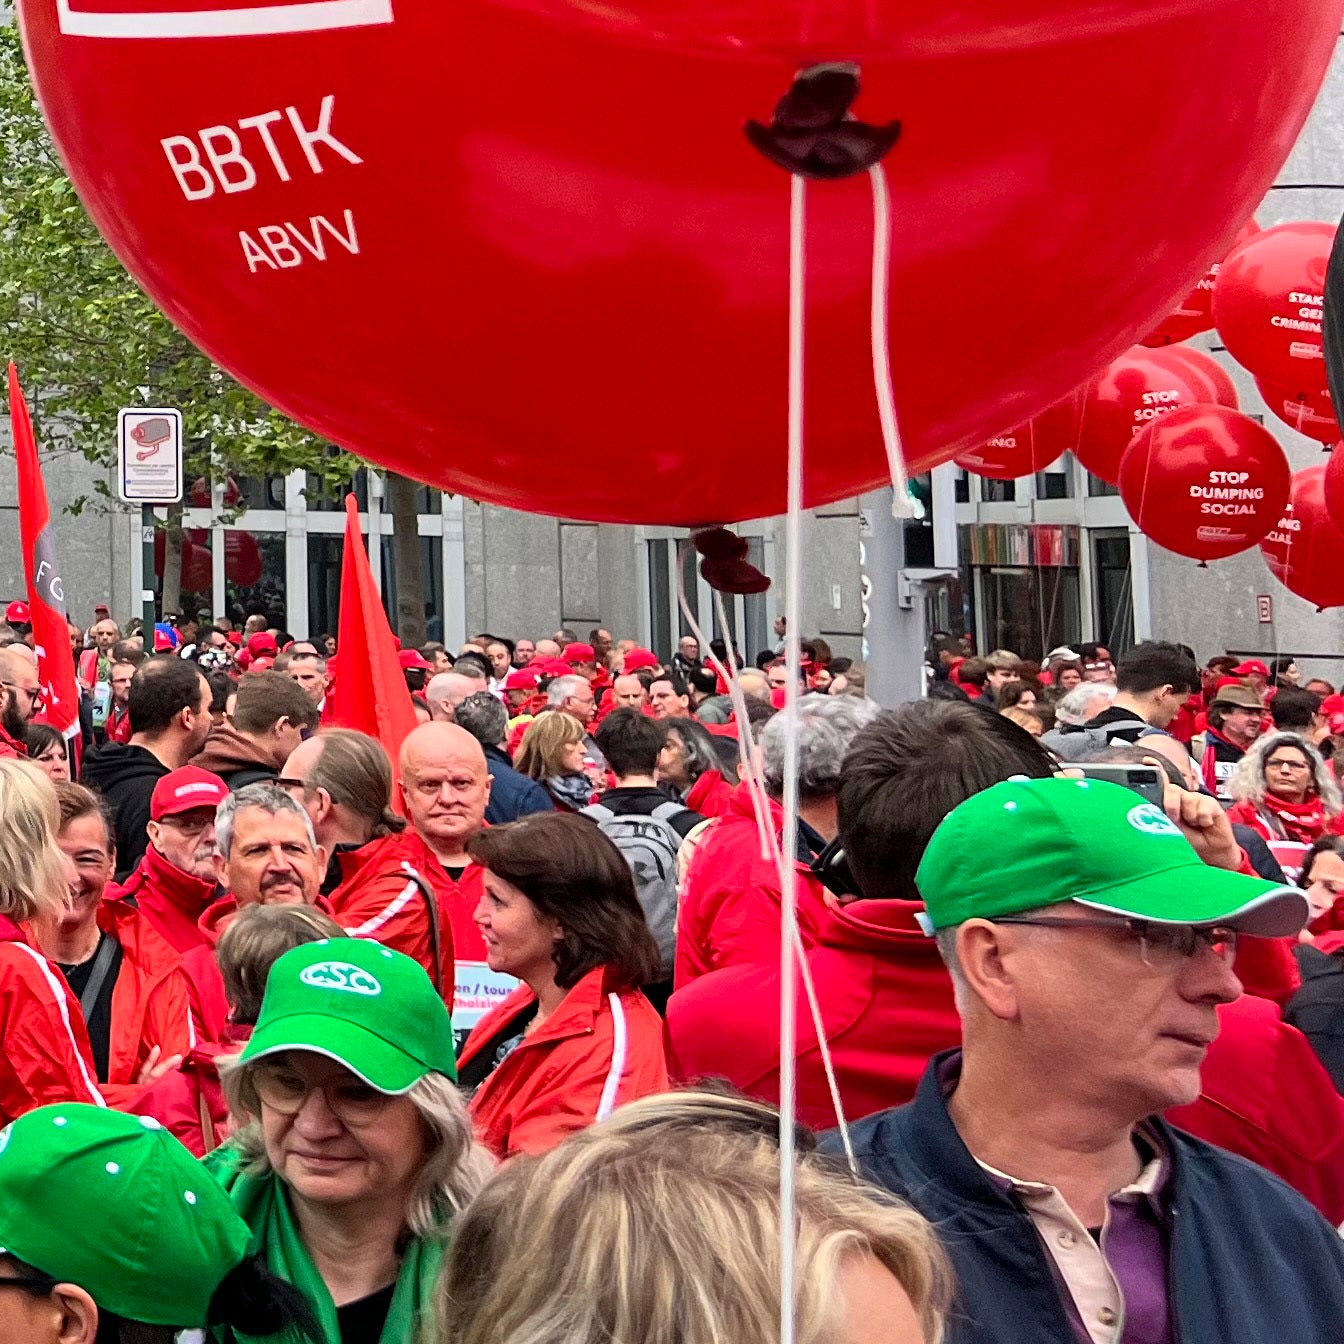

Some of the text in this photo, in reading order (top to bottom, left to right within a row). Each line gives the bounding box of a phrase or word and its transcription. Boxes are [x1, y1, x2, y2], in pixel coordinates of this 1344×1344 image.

[160, 94, 364, 201] BBTK
[238, 209, 360, 273] ABVV
[1142, 390, 1179, 405] STOP
[1209, 471, 1250, 485] STOP
[1190, 485, 1264, 501] DUMPING
[1200, 502, 1257, 515] SOCIAL
[302, 963, 379, 993] CSC
